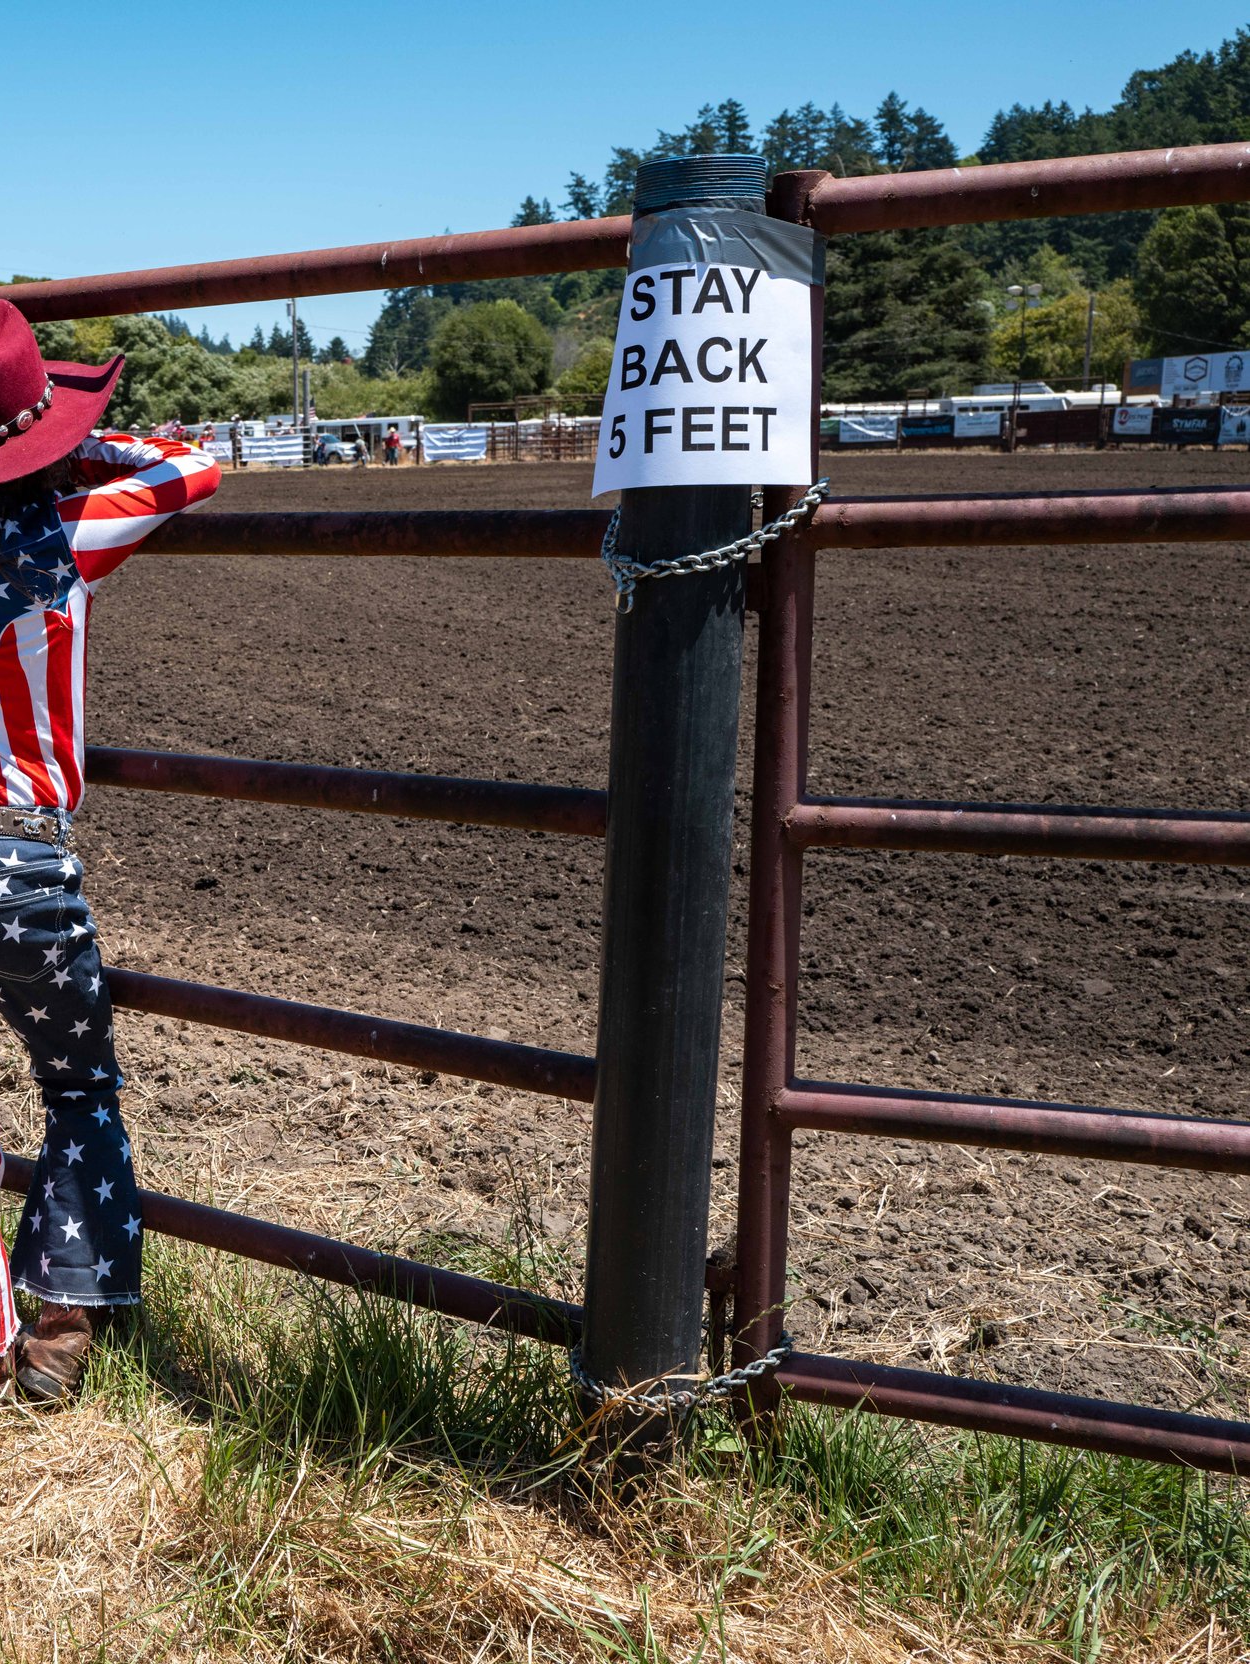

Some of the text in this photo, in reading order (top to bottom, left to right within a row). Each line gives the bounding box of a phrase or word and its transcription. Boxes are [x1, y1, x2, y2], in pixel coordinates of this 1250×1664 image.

[630, 267, 760, 322] STAY
[620, 336, 768, 391] BACK
[609, 406, 777, 459] 5 FEET
